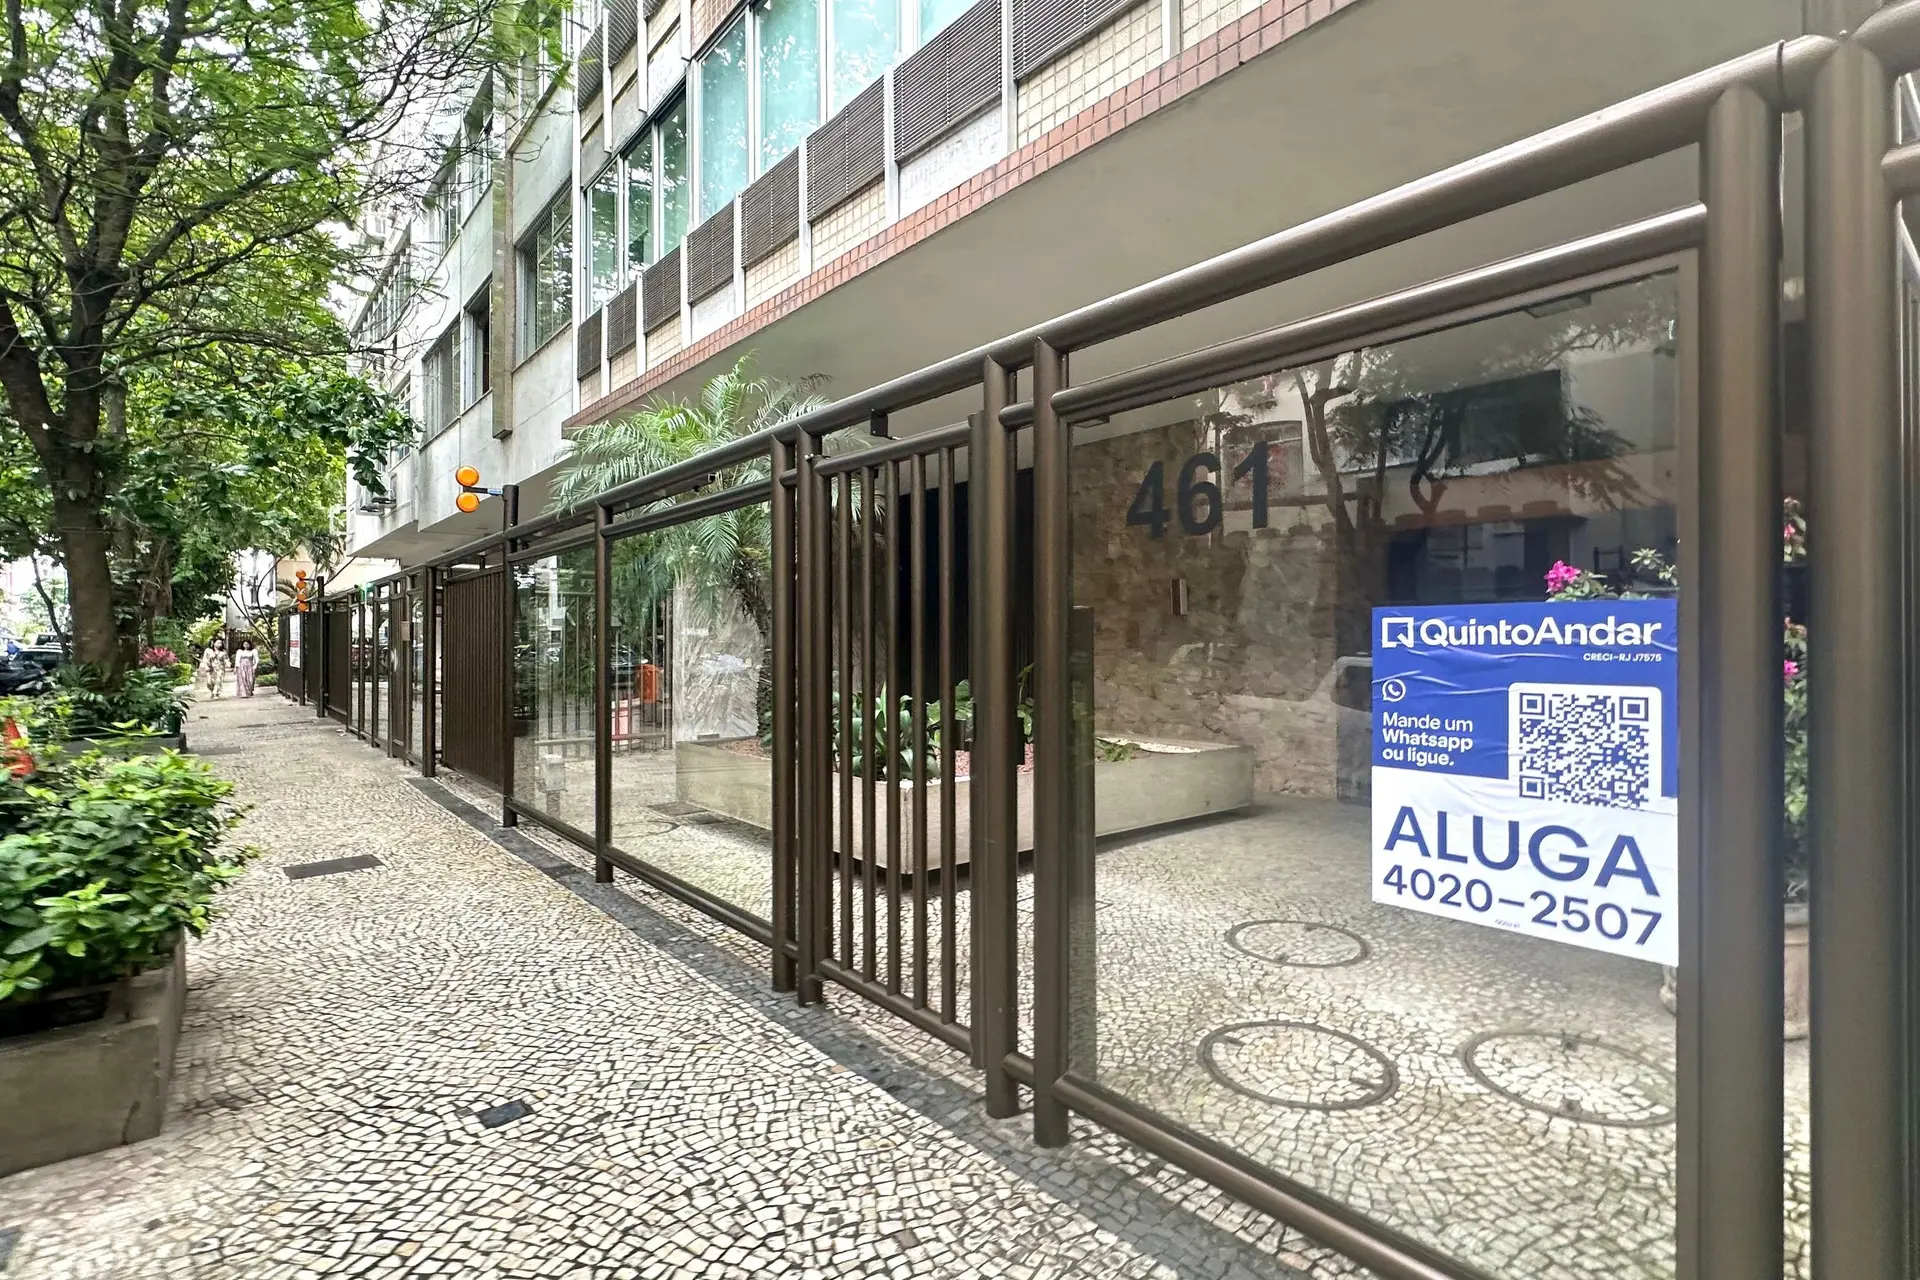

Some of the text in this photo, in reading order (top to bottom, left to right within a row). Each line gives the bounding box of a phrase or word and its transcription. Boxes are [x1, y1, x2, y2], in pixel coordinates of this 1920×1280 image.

[1126, 441, 1268, 539] 461
[1419, 615, 1662, 648] QuintoAndar
[1583, 652, 1631, 662] CRECI-RJ
[1382, 711, 1474, 733] Mande um
[1382, 728, 1474, 753] Whatsapp
[1382, 747, 1455, 767] ou ligue.
[1383, 805, 1661, 898] ALUGA
[1383, 863, 1663, 947] 4020-2507
